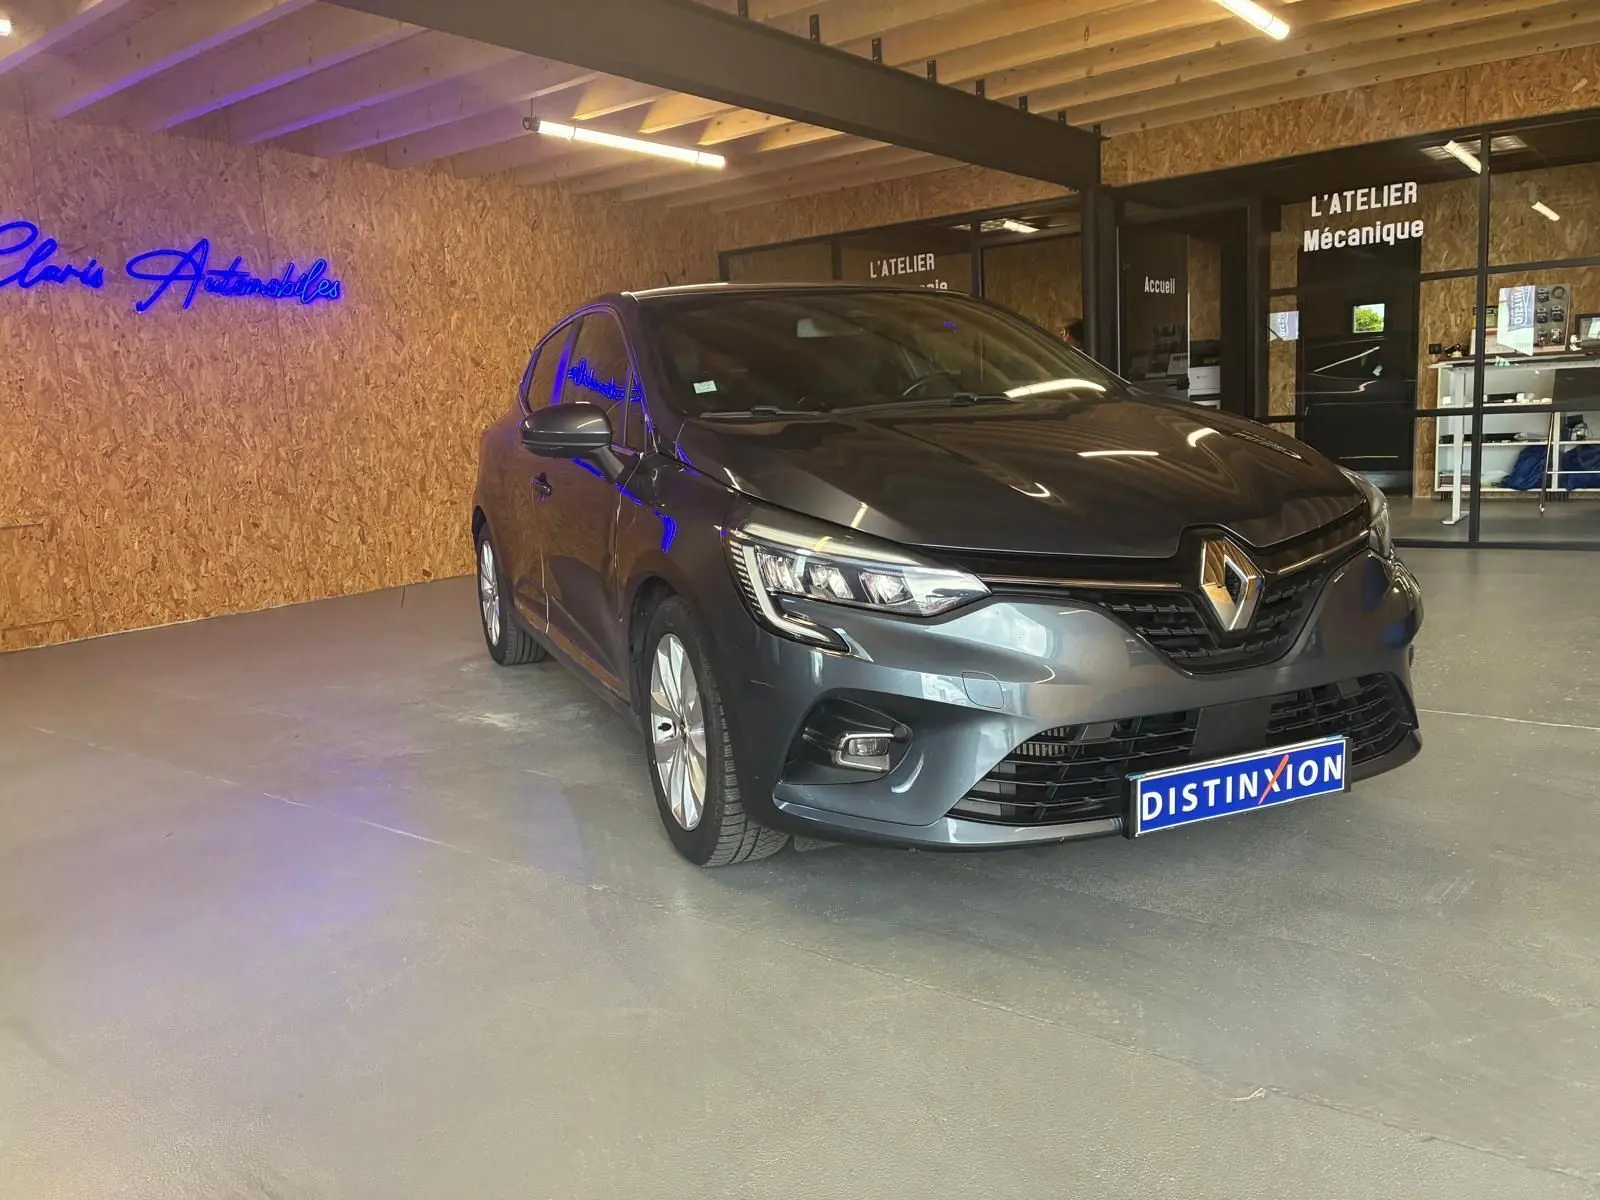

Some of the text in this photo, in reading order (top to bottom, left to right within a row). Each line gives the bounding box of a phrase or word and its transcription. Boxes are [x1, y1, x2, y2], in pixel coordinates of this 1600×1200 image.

[1311, 181, 1418, 217] L'ATELIER
[1303, 219, 1424, 252] Mécanique
[126, 238, 341, 312] Automobiles
[869, 252, 935, 279] L'ATELIER
[1144, 276, 1175, 294] Accueil
[1142, 754, 1342, 821] DISTINXION
